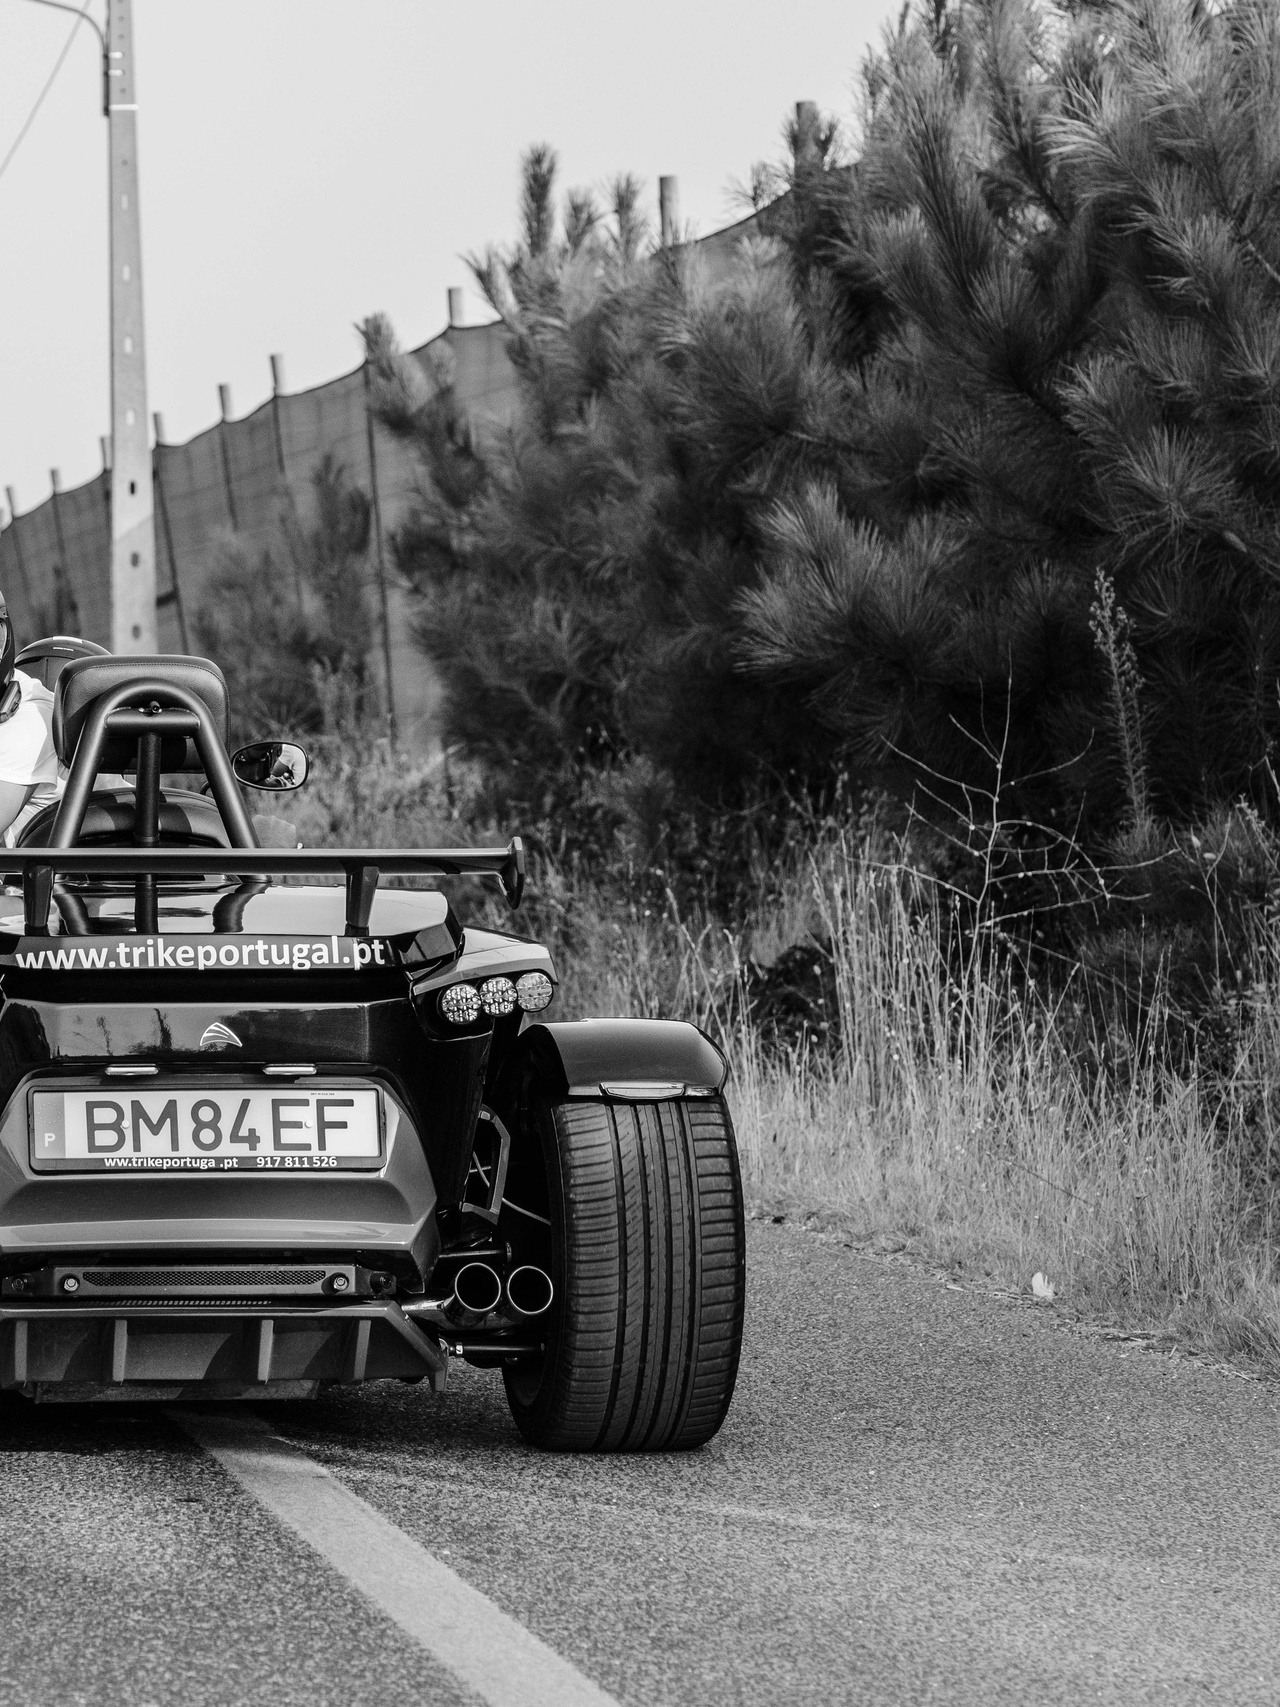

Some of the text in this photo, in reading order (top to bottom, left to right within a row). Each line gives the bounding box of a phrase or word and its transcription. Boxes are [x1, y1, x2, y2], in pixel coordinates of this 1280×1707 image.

[15, 935, 386, 970] www.trikeportugal.pt
[44, 1132, 56, 1148] P
[256, 1156, 281, 1168] 917
[284, 1156, 310, 1168] 811
[312, 1156, 338, 1168] 526
